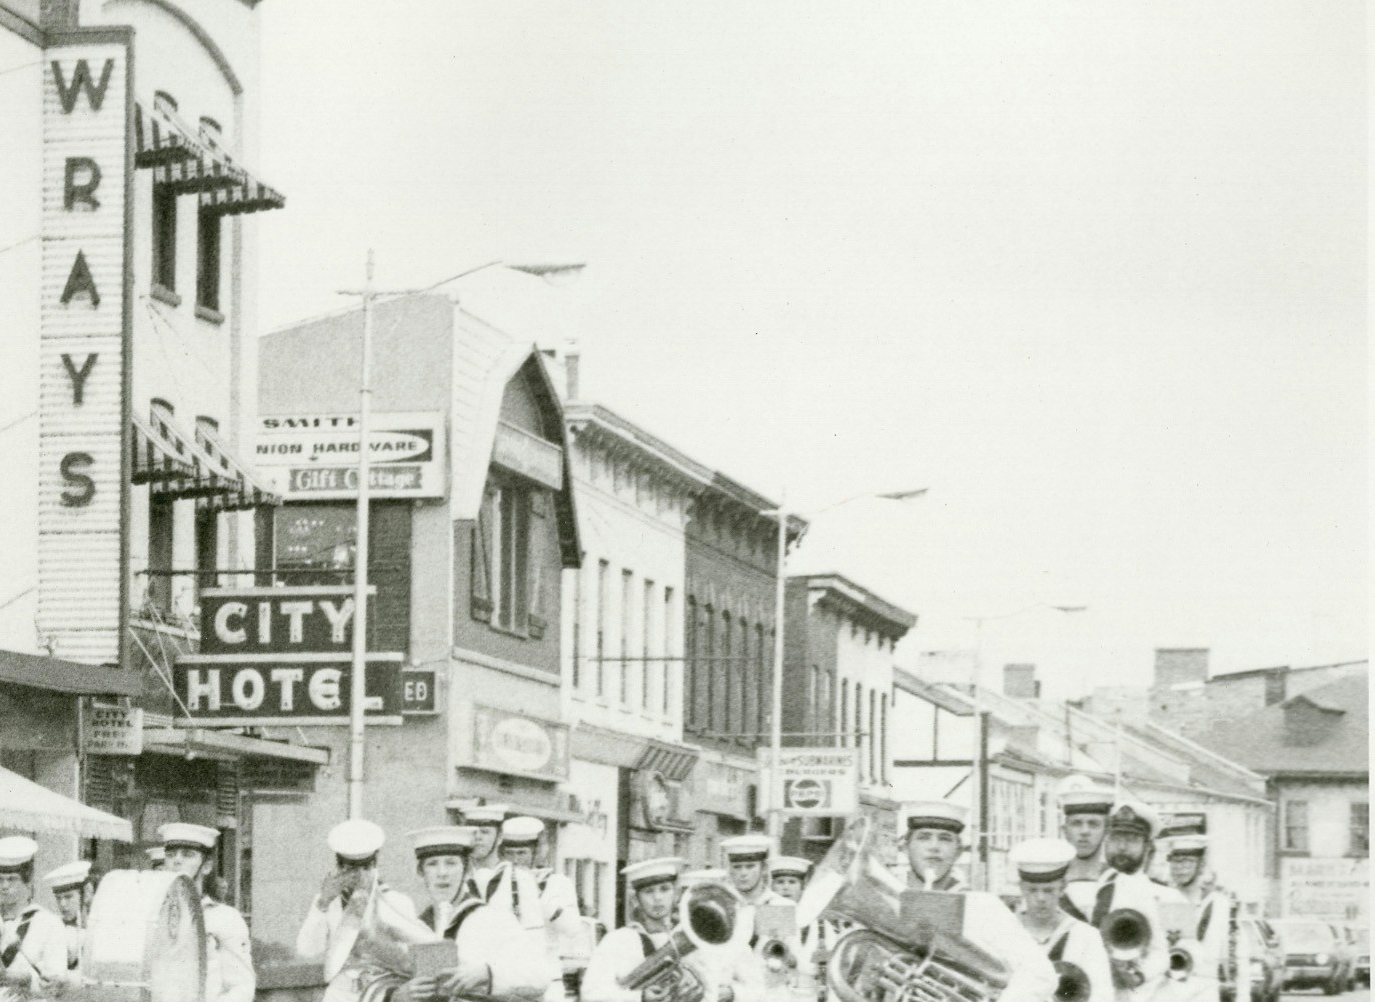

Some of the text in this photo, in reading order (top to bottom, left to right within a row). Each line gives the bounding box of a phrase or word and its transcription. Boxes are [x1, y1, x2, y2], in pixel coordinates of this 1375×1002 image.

[51, 57, 115, 508] WRAYS
[256, 443, 303, 455] NION
[295, 467, 415, 491] Gift Cttage
[214, 597, 355, 645] CITY
